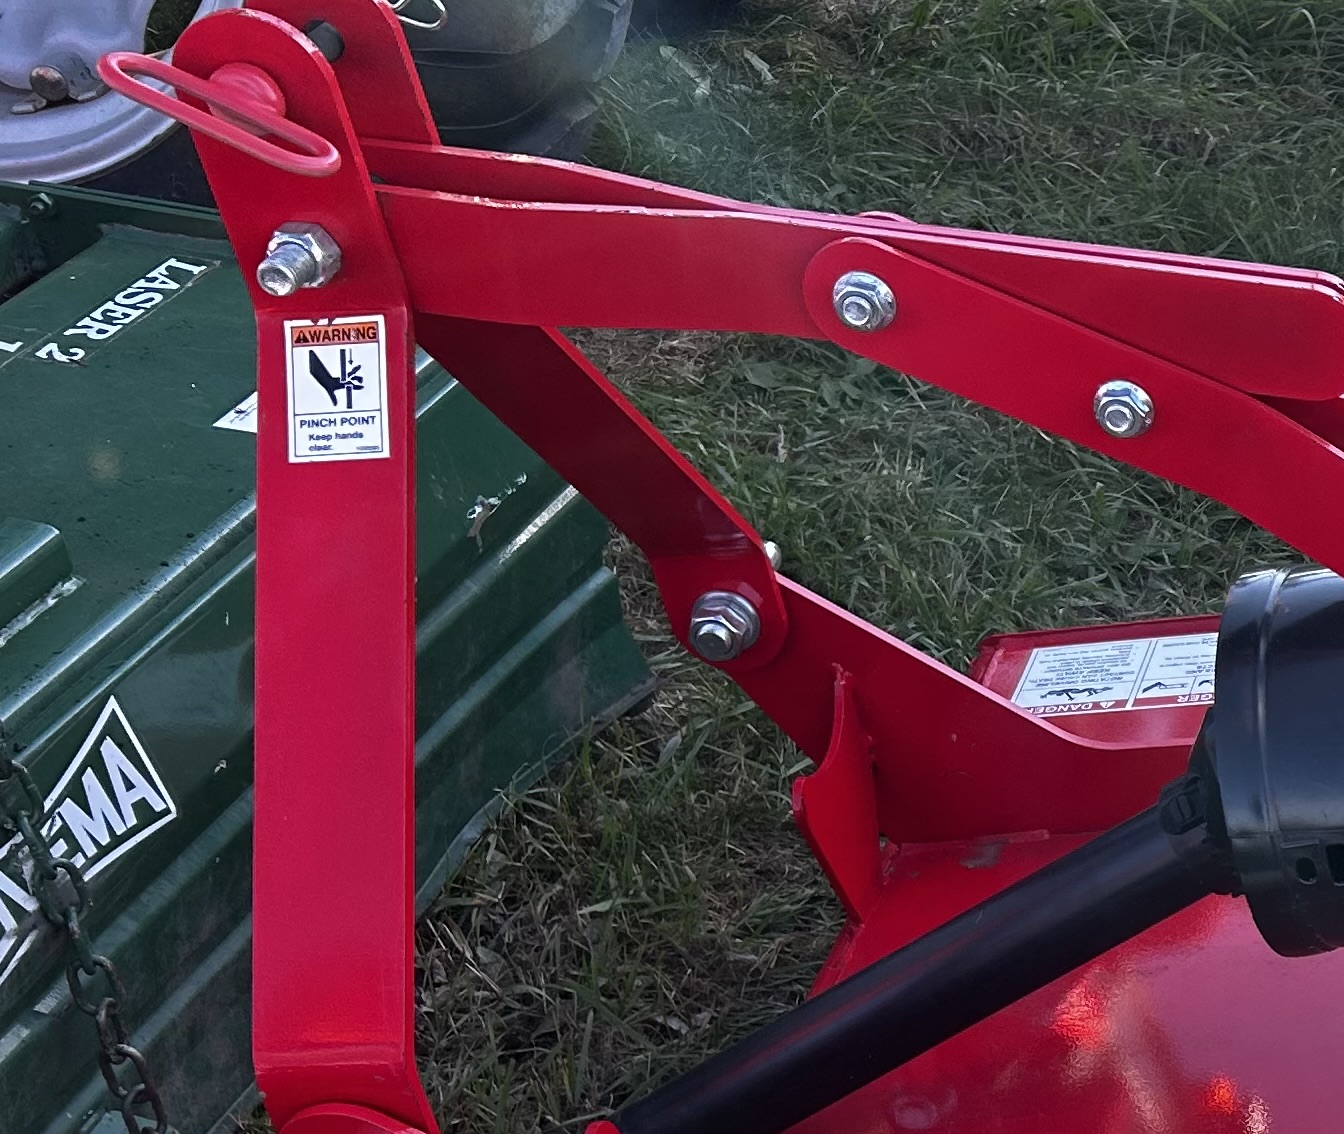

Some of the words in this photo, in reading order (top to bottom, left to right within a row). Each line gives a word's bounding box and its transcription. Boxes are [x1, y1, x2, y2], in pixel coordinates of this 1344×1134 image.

[64, 257, 208, 340] LASER
[35, 342, 86, 363] 2
[300, 418, 337, 429] PINCH
[341, 415, 377, 427] POINT
[308, 433, 333, 443] Keep
[335, 431, 364, 440] hands
